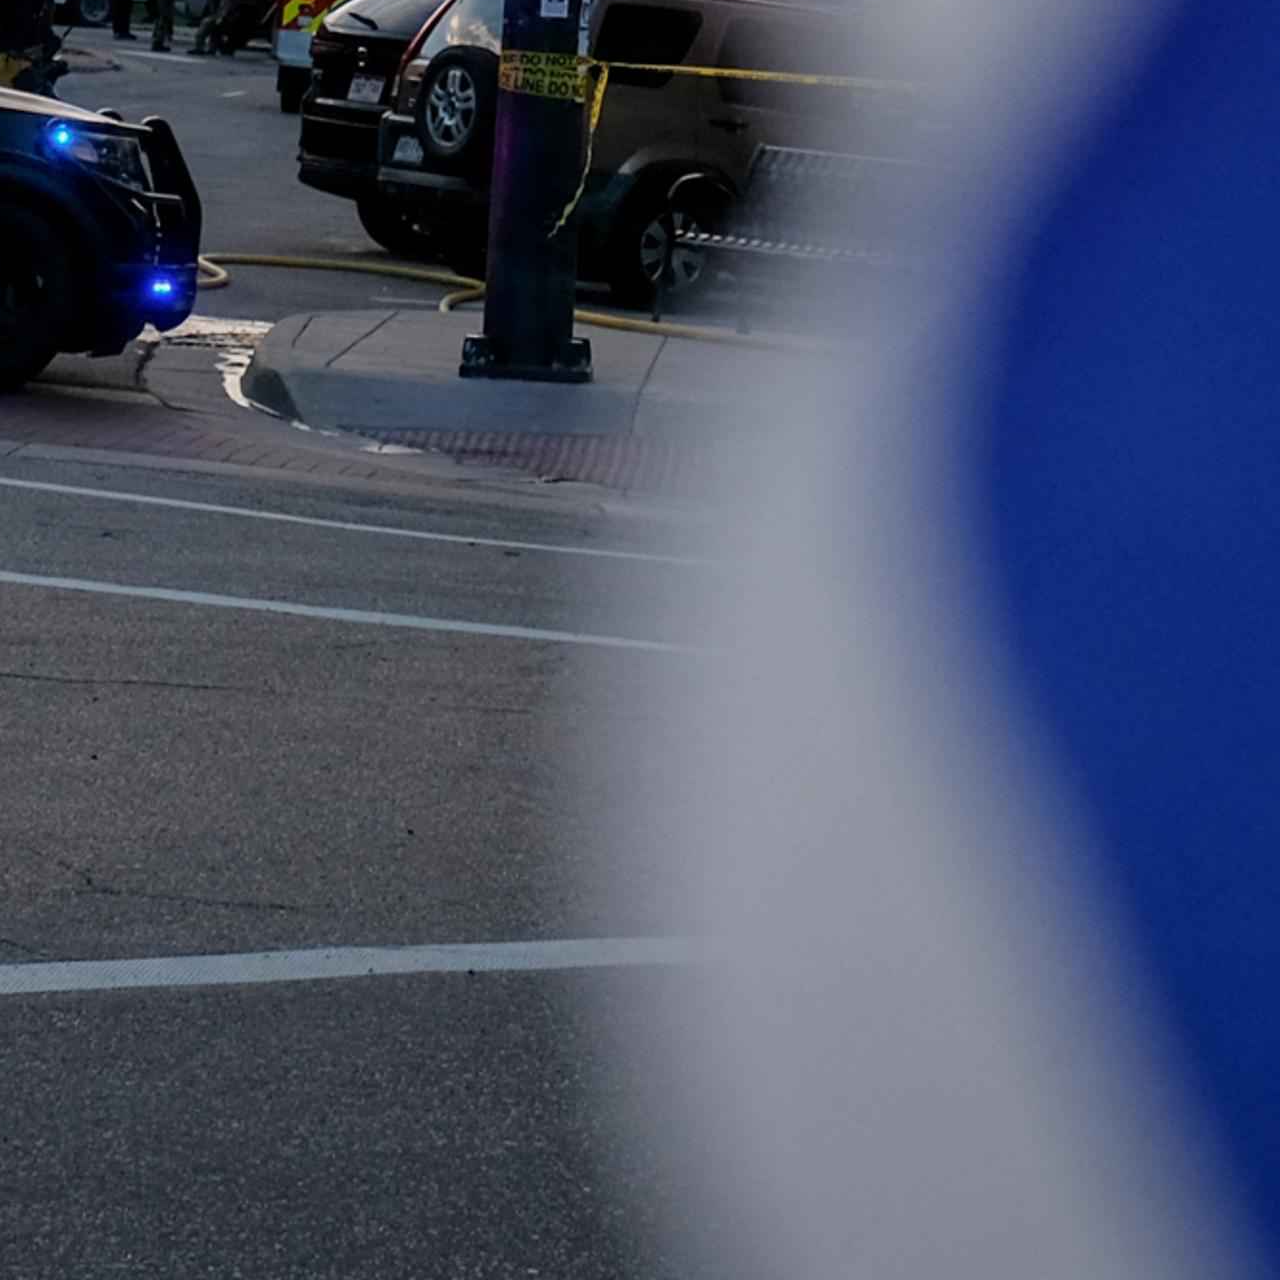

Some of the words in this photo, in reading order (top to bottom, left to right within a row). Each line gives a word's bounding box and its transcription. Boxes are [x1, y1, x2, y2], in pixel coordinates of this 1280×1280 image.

[520, 53, 541, 65] DO
[546, 55, 574, 66] NOT
[514, 74, 544, 93] LINE
[548, 81, 569, 96] DO
